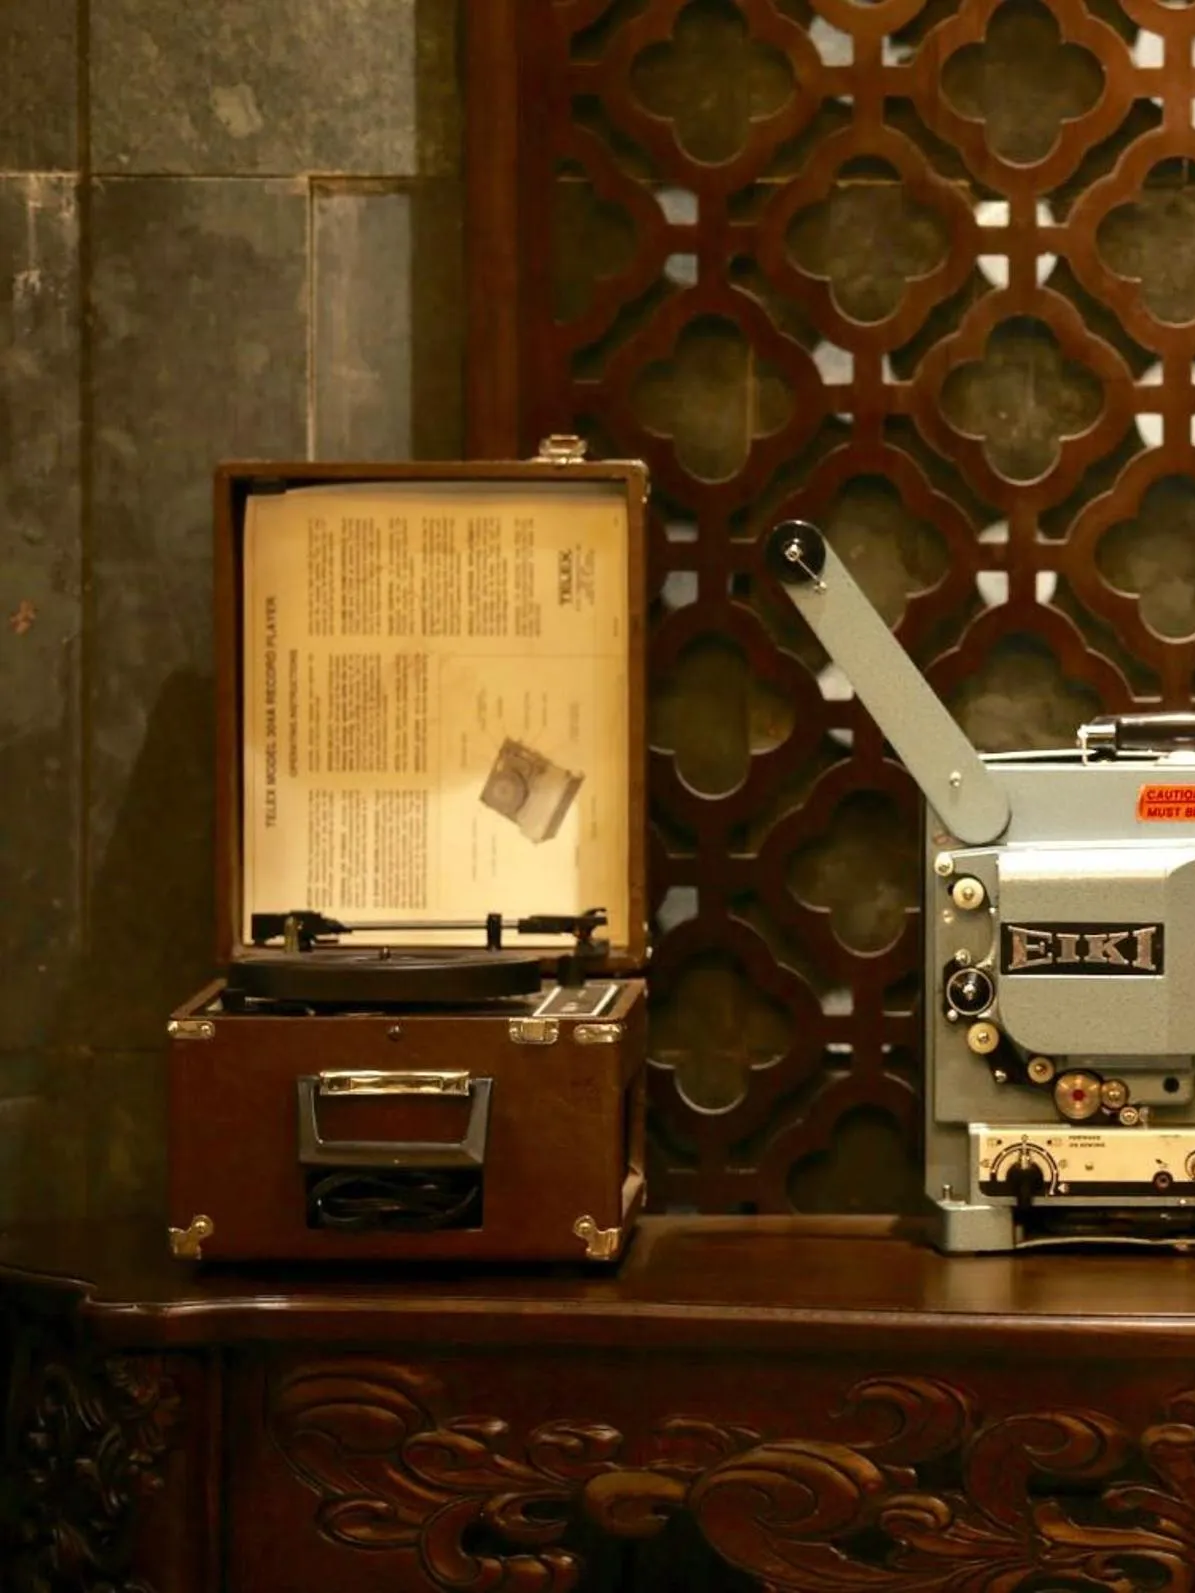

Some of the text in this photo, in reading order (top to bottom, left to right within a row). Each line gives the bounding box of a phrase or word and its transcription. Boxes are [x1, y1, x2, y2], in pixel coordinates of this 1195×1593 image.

[265, 597, 277, 648] PLAYER
[265, 650, 277, 705] RECORD
[265, 741, 277, 786] MODEL
[1147, 807, 1181, 818] MUST
[1008, 925, 1157, 971] EIKI
